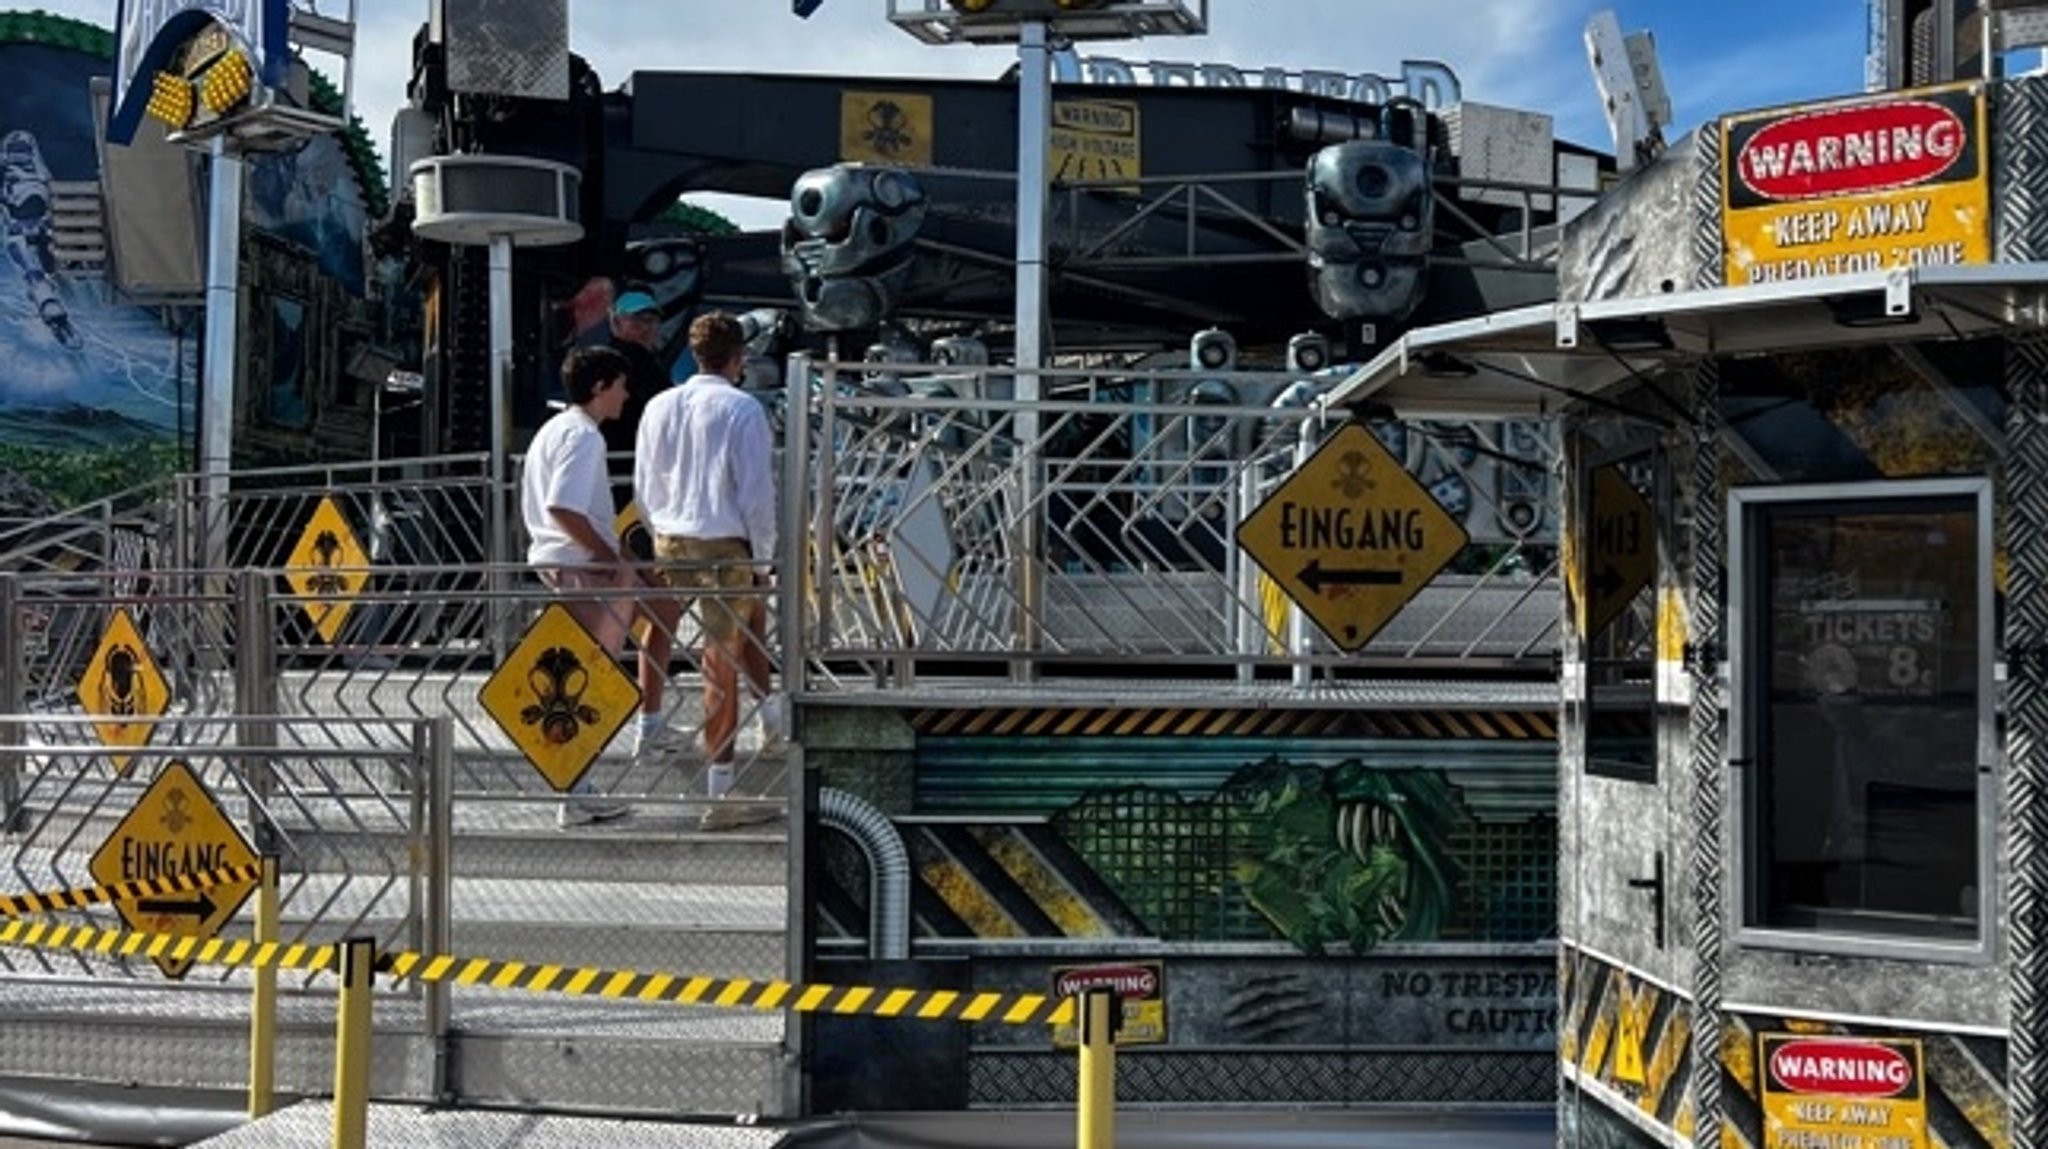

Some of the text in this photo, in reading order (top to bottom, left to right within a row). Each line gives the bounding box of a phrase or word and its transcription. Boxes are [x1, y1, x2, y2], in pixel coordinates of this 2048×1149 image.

[1750, 120, 1955, 180] WARNING
[1773, 200, 1929, 247] KEEP AWAY
[1281, 502, 1424, 551] EINGANG
[1806, 613, 1935, 643] TICKETS
[1381, 971, 1432, 998] NO
[1777, 1053, 1906, 1084] WARNING
[1794, 1100, 1893, 1127] KEEP AWAY
